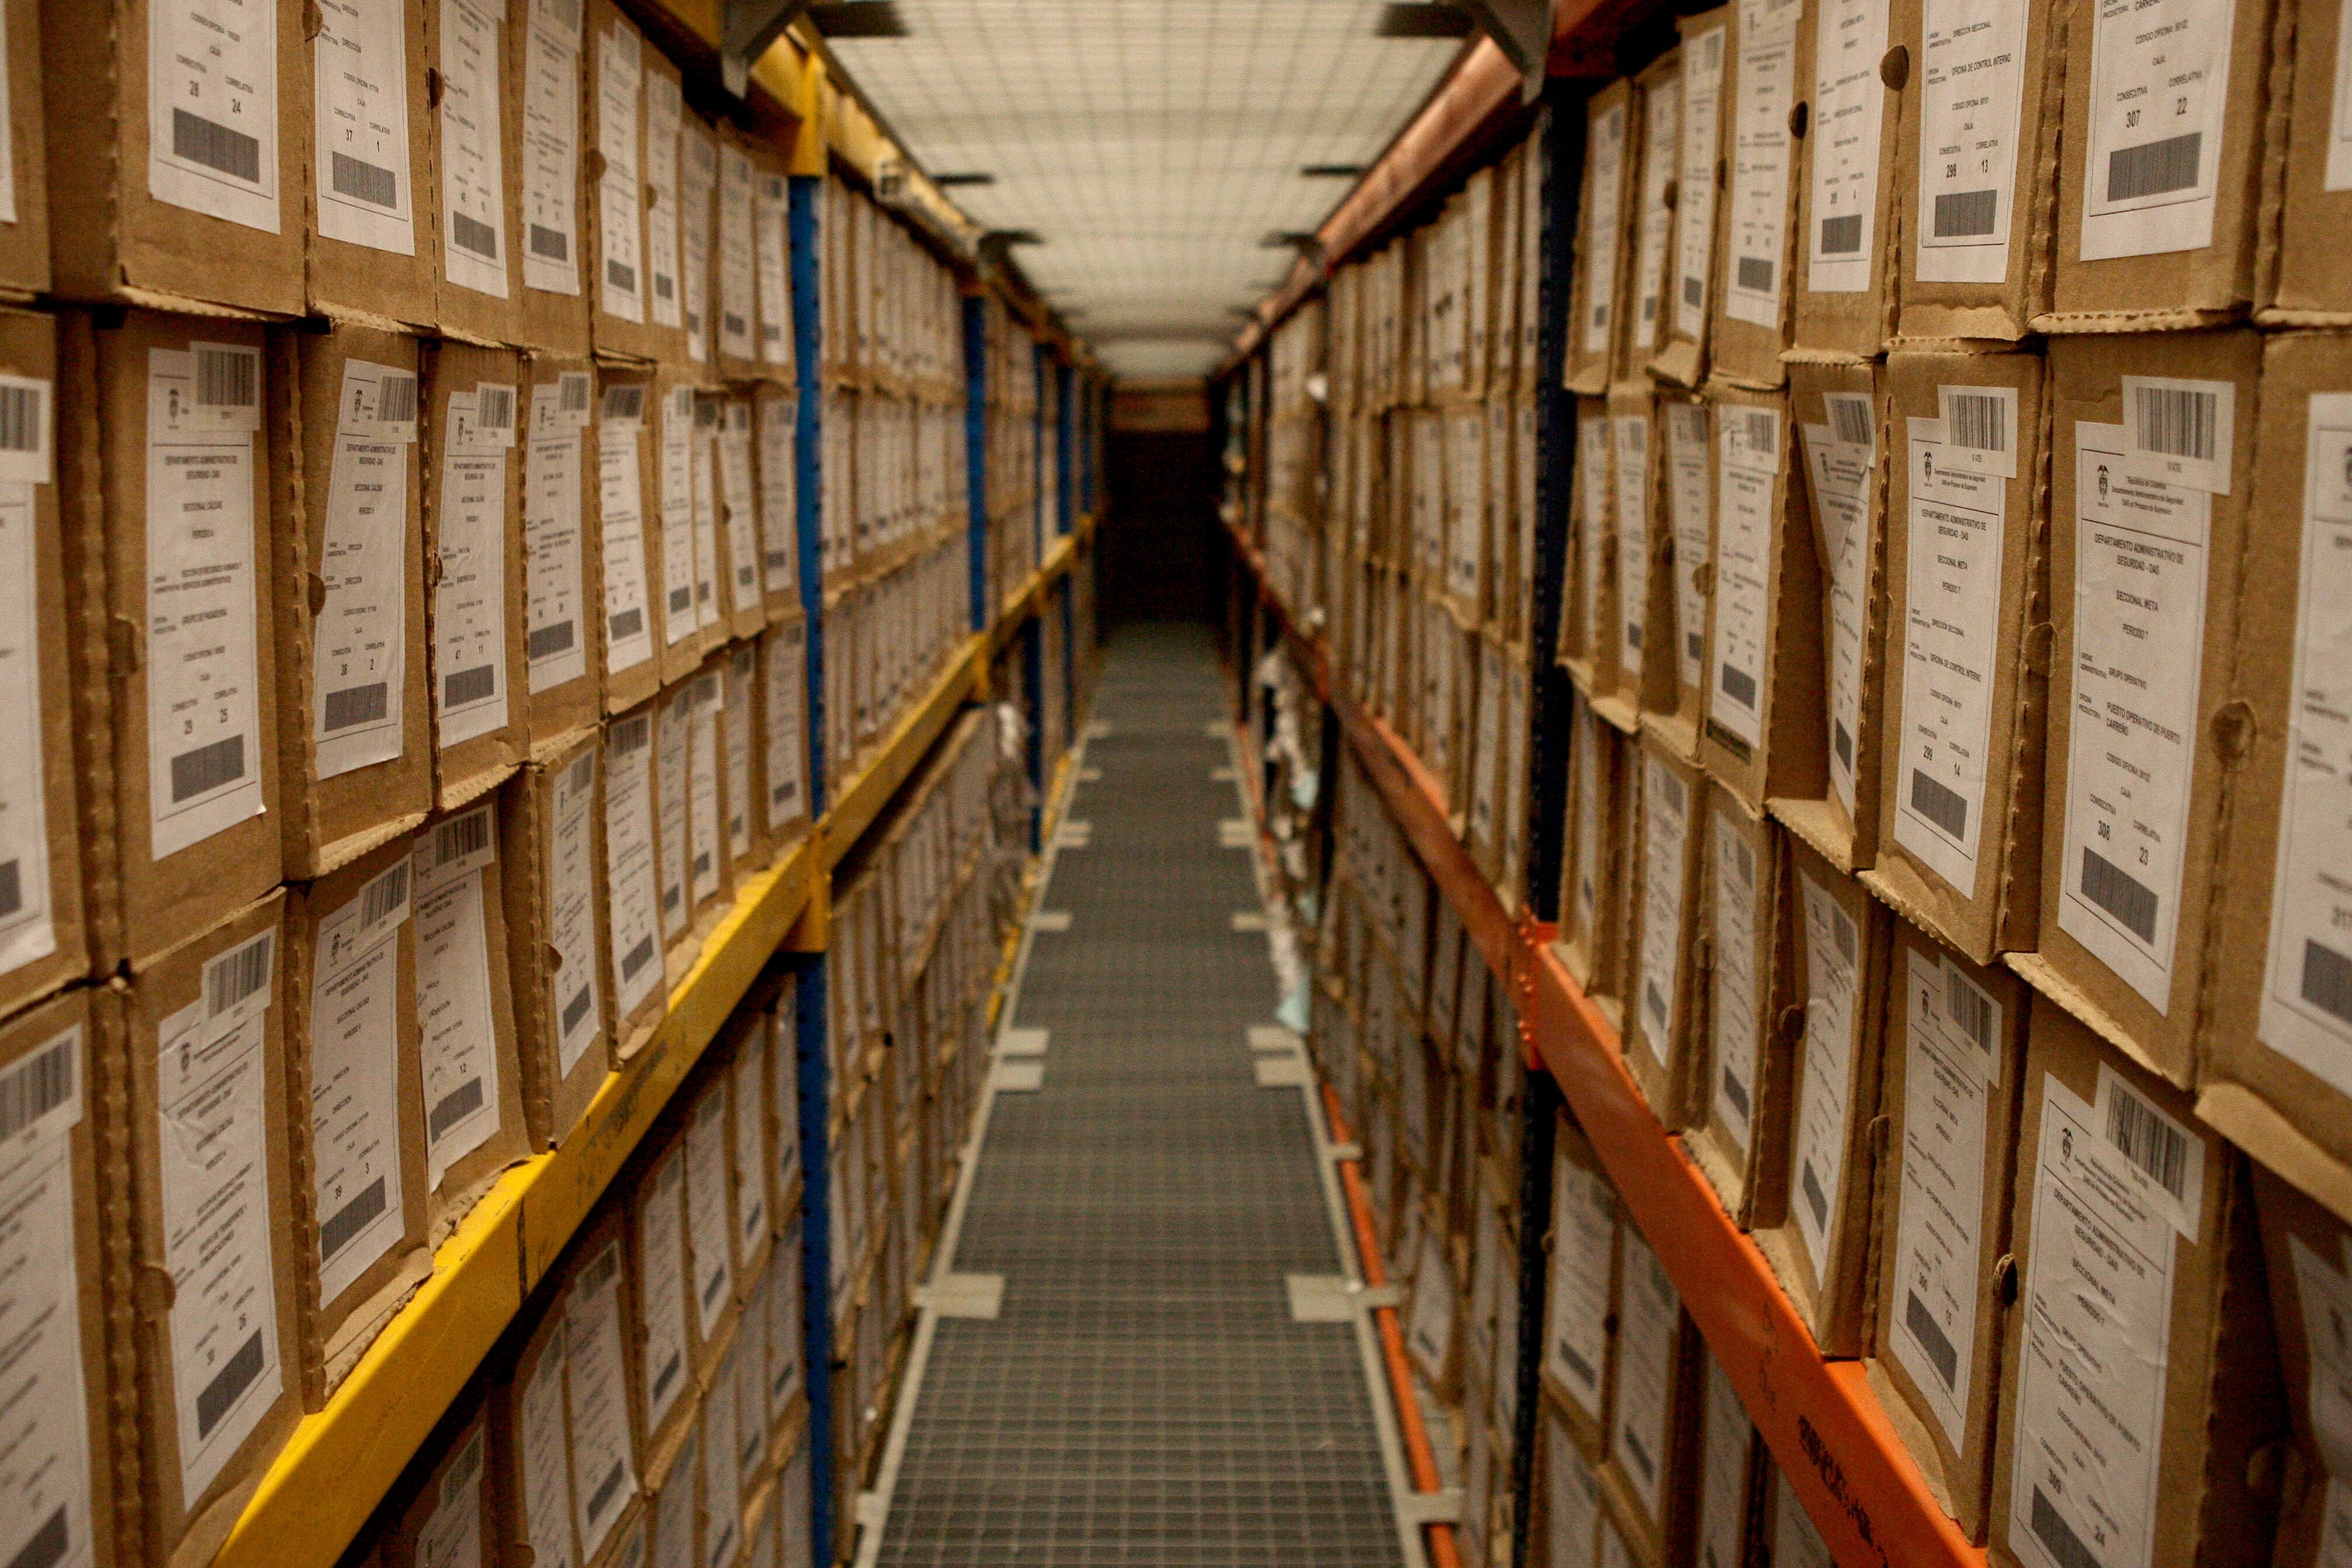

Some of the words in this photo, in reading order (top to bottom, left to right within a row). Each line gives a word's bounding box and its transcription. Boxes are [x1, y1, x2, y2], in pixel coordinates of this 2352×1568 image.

[2136, 32, 2154, 45] CODIGO
[1952, 65, 1967, 76] OFICINA
[1967, 63, 1973, 72] DE
[1974, 59, 1992, 71] CONTROL
[1993, 53, 2011, 66] INTERNO
[2169, 70, 2202, 88] CORRELATIVA
[2117, 86, 2147, 102] CONSECUTIVA
[233, 99, 241, 114] 24
[334, 107, 356, 122] CONSECUTIVA
[2177, 97, 2187, 116] 22
[2126, 109, 2141, 129] 307
[346, 129, 353, 142] 37
[369, 122, 390, 135] CORRELATIVA
[377, 140, 380, 153] 1
[1939, 145, 1960, 155] CONSECUTIVA
[1976, 140, 1998, 150] CORRELATIVA
[1946, 164, 1956, 178] 298
[1982, 159, 1989, 174] 13
[2112, 485, 2134, 496] Departamento
[2135, 490, 2160, 501] Administrativo
[2166, 495, 2183, 505] Seguridad
[2135, 502, 2149, 511] Proceso
[1922, 509, 1949, 522] DEPARTAMENTO
[1950, 515, 1980, 530] ADMINISTRATIVO
[1980, 522, 1987, 531] DE
[1938, 525, 1958, 538] SEGURIDAD
[2094, 533, 2133, 551] DEPARTAMENTO
[2134, 543, 2176, 563] ADMINISTRATIVO
[2176, 554, 2184, 565] DE
[1937, 554, 1957, 567] SECCIONAL
[1958, 560, 1967, 570] META
[2117, 555, 2145, 571] SEGURIDAD
[2149, 564, 2160, 575] DAS
[1942, 581, 1958, 594] PERIODO
[2117, 590, 2143, 607] SECCIONAL
[2145, 599, 2159, 612] META
[1948, 624, 1965, 637] SECCIONAL
[2122, 623, 2144, 640] PERIODO
[341, 663, 348, 676] 38
[369, 659, 374, 670] 2
[1930, 654, 1944, 666] OFICINA
[1944, 660, 1949, 668] DE
[1949, 661, 1965, 676] CONTROL
[1966, 669, 1982, 682] INTERNO
[2109, 667, 2123, 680] GRUPO
[2124, 673, 2147, 690] OPERATIVO
[2107, 702, 2125, 718] PUESTO
[2126, 710, 2153, 731] OPERATIVO
[2153, 723, 2160, 736] DE
[2161, 727, 2181, 745] PUERTO
[2107, 717, 2129, 736] CARREÑO
[1918, 724, 1937, 740] CONSECUTIVA
[1923, 745, 1933, 761] 299
[1949, 741, 1970, 758] CORRELATIVA
[2107, 752, 2121, 766] CODIGO
[1954, 762, 1960, 778] 14
[2090, 793, 2117, 815] CONSECUTIVA
[2098, 820, 2110, 841] 308
[2133, 820, 2161, 842] CORRELATIVA
[2139, 847, 2148, 866] 23
[460, 1063, 466, 1074] 12
[366, 1162, 369, 1174] 3
[335, 1185, 342, 1199] 39
[2055, 1188, 2091, 1229] DEPARTAMENTO
[2093, 1226, 2136, 1271] ADMINISTRATIVO
[2136, 1262, 2145, 1279] DE
[2076, 1224, 2104, 1258] SEGURIDAD
[2072, 1258, 2100, 1291] SECCIONAL
[2101, 1286, 2115, 1306] META
[2077, 1294, 2101, 1323] PERIODO
[1946, 1309, 1952, 1325] 15
[2079, 1381, 2108, 1418] OPERATIVO
[2048, 1468, 2061, 1494] 309
[2094, 1525, 2104, 1547] 24
